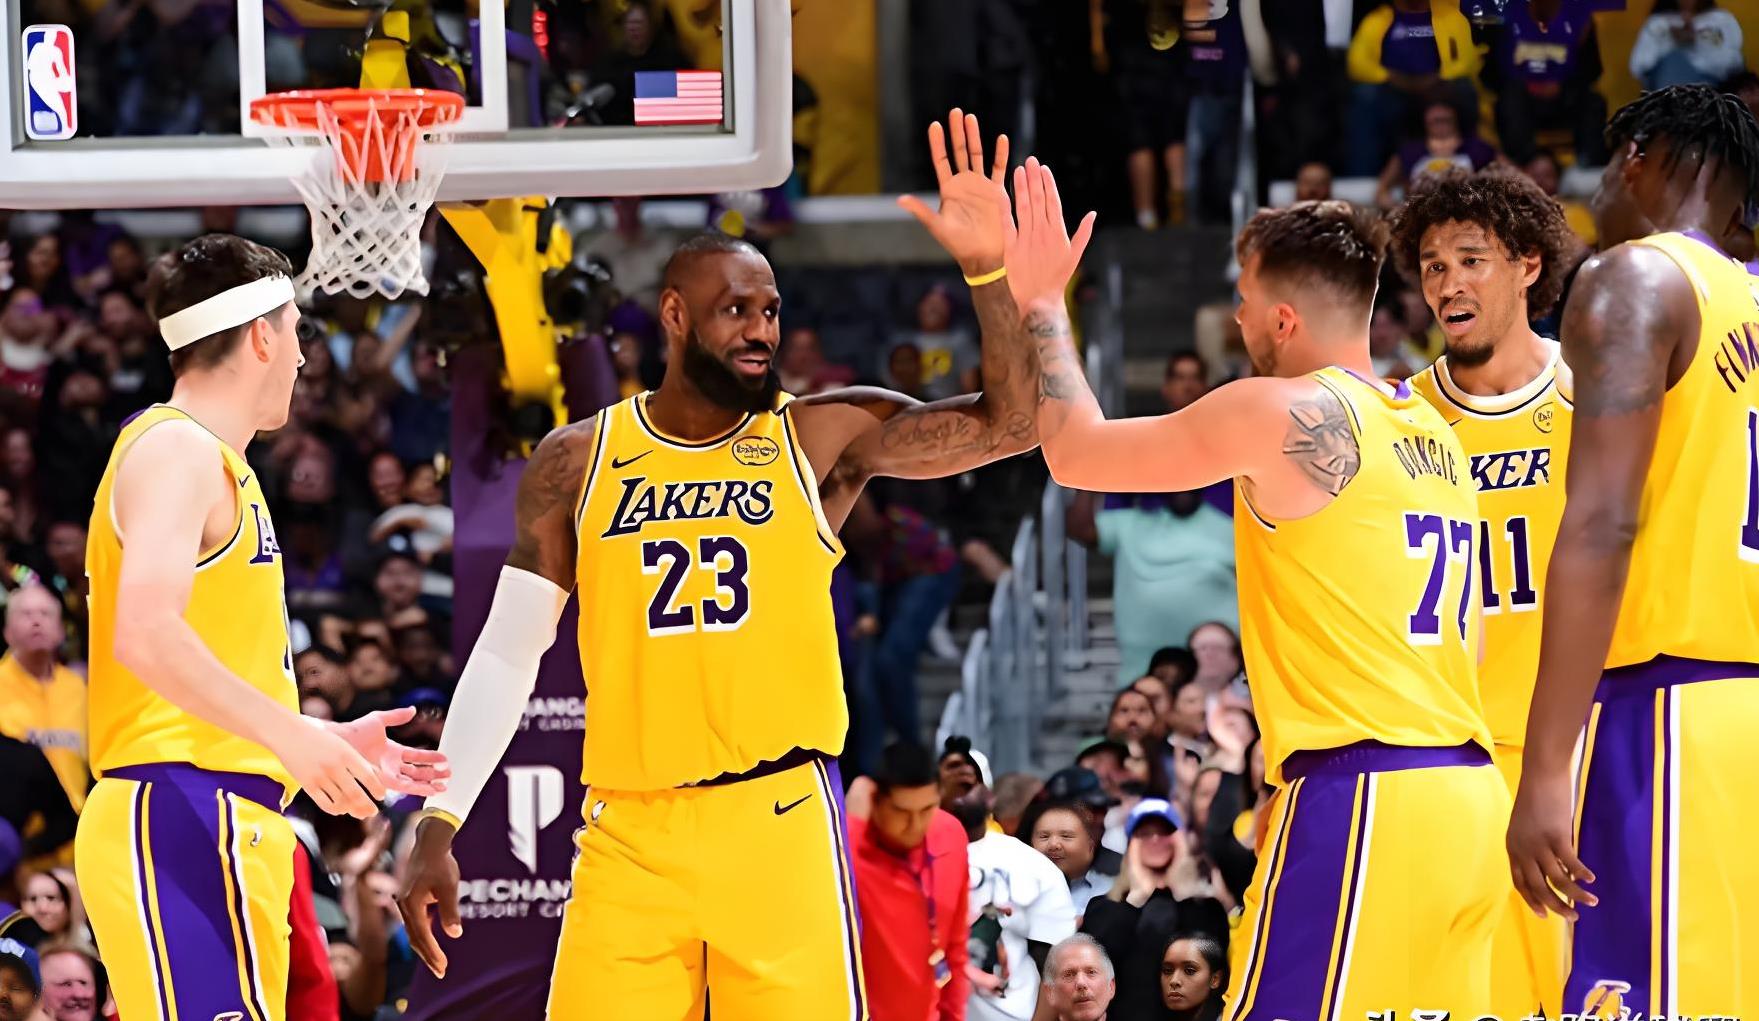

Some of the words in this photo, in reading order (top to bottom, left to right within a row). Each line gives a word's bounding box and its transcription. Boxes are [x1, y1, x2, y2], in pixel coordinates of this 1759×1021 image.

[600, 476, 774, 539] LAKERS
[1470, 448, 1551, 492] KER
[642, 535, 749, 637] 23
[1405, 511, 1474, 645] 77
[1479, 516, 1538, 615] 11
[458, 879, 571, 902] PECHAN
